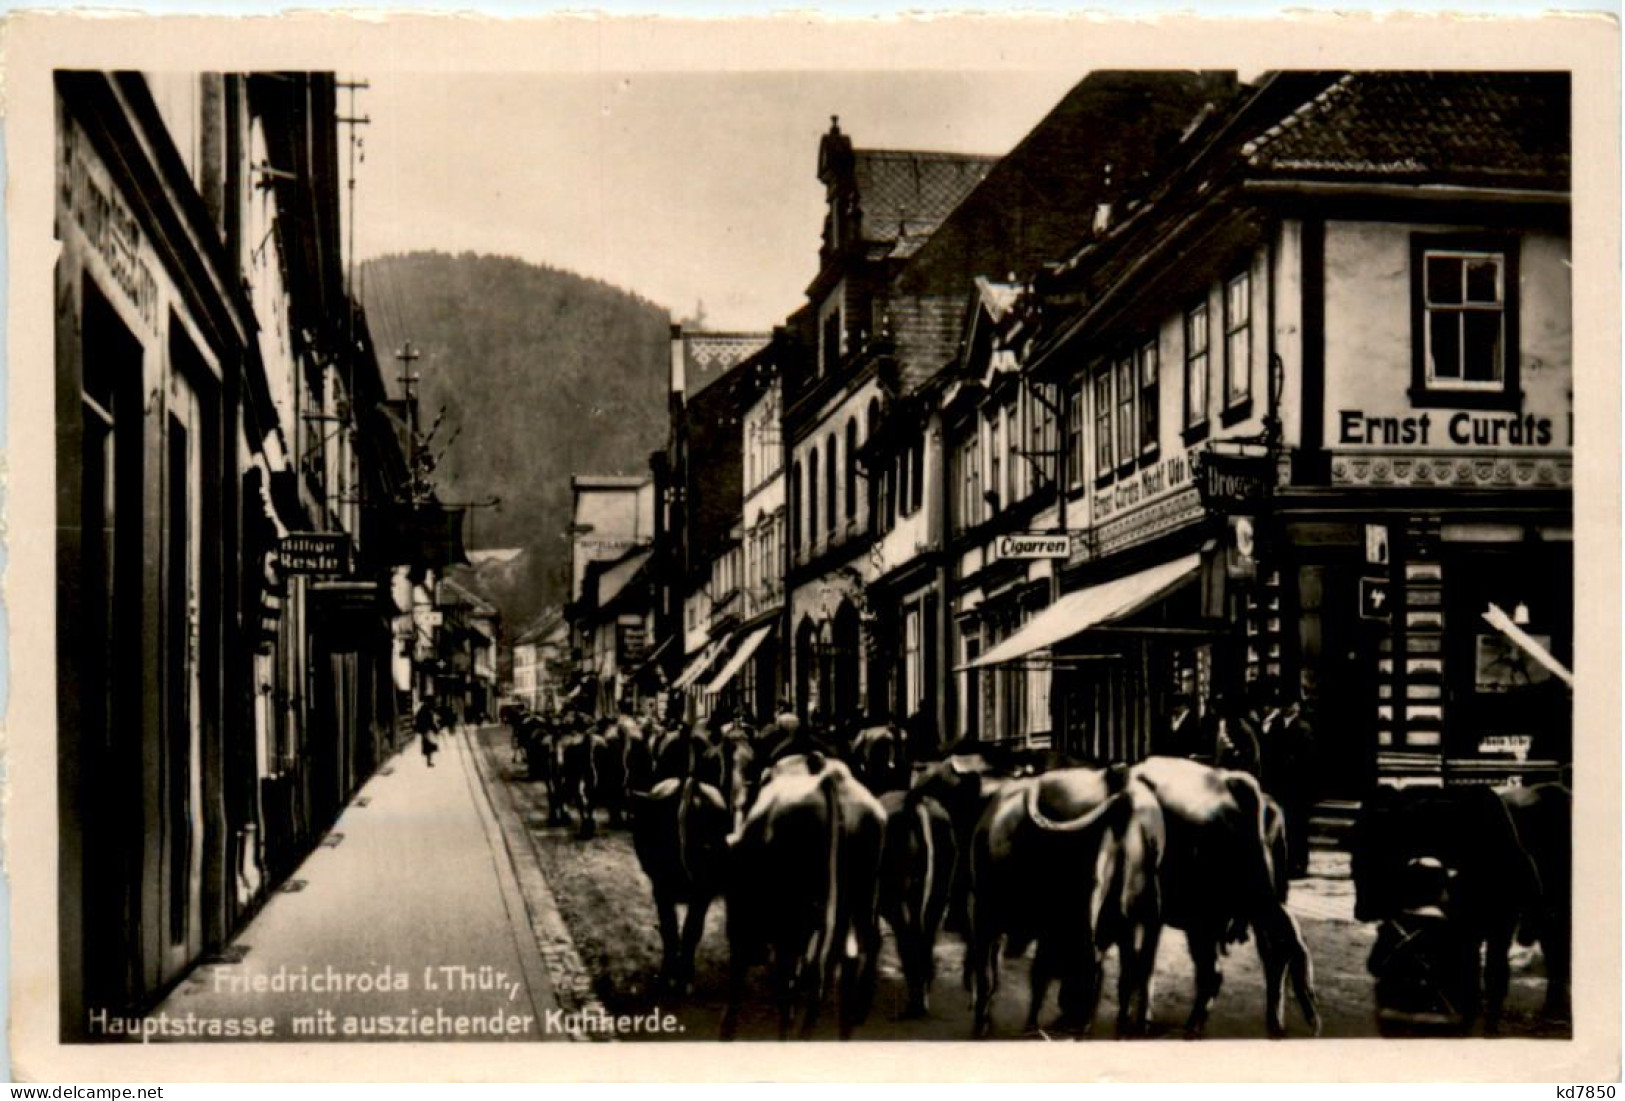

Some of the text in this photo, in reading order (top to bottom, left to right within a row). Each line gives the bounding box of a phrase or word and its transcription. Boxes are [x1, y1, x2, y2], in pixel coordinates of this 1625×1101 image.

[1338, 410, 1430, 444] Ernst
[1448, 412, 1553, 445] Curdts
[1001, 536, 1066, 556] Cigarren
